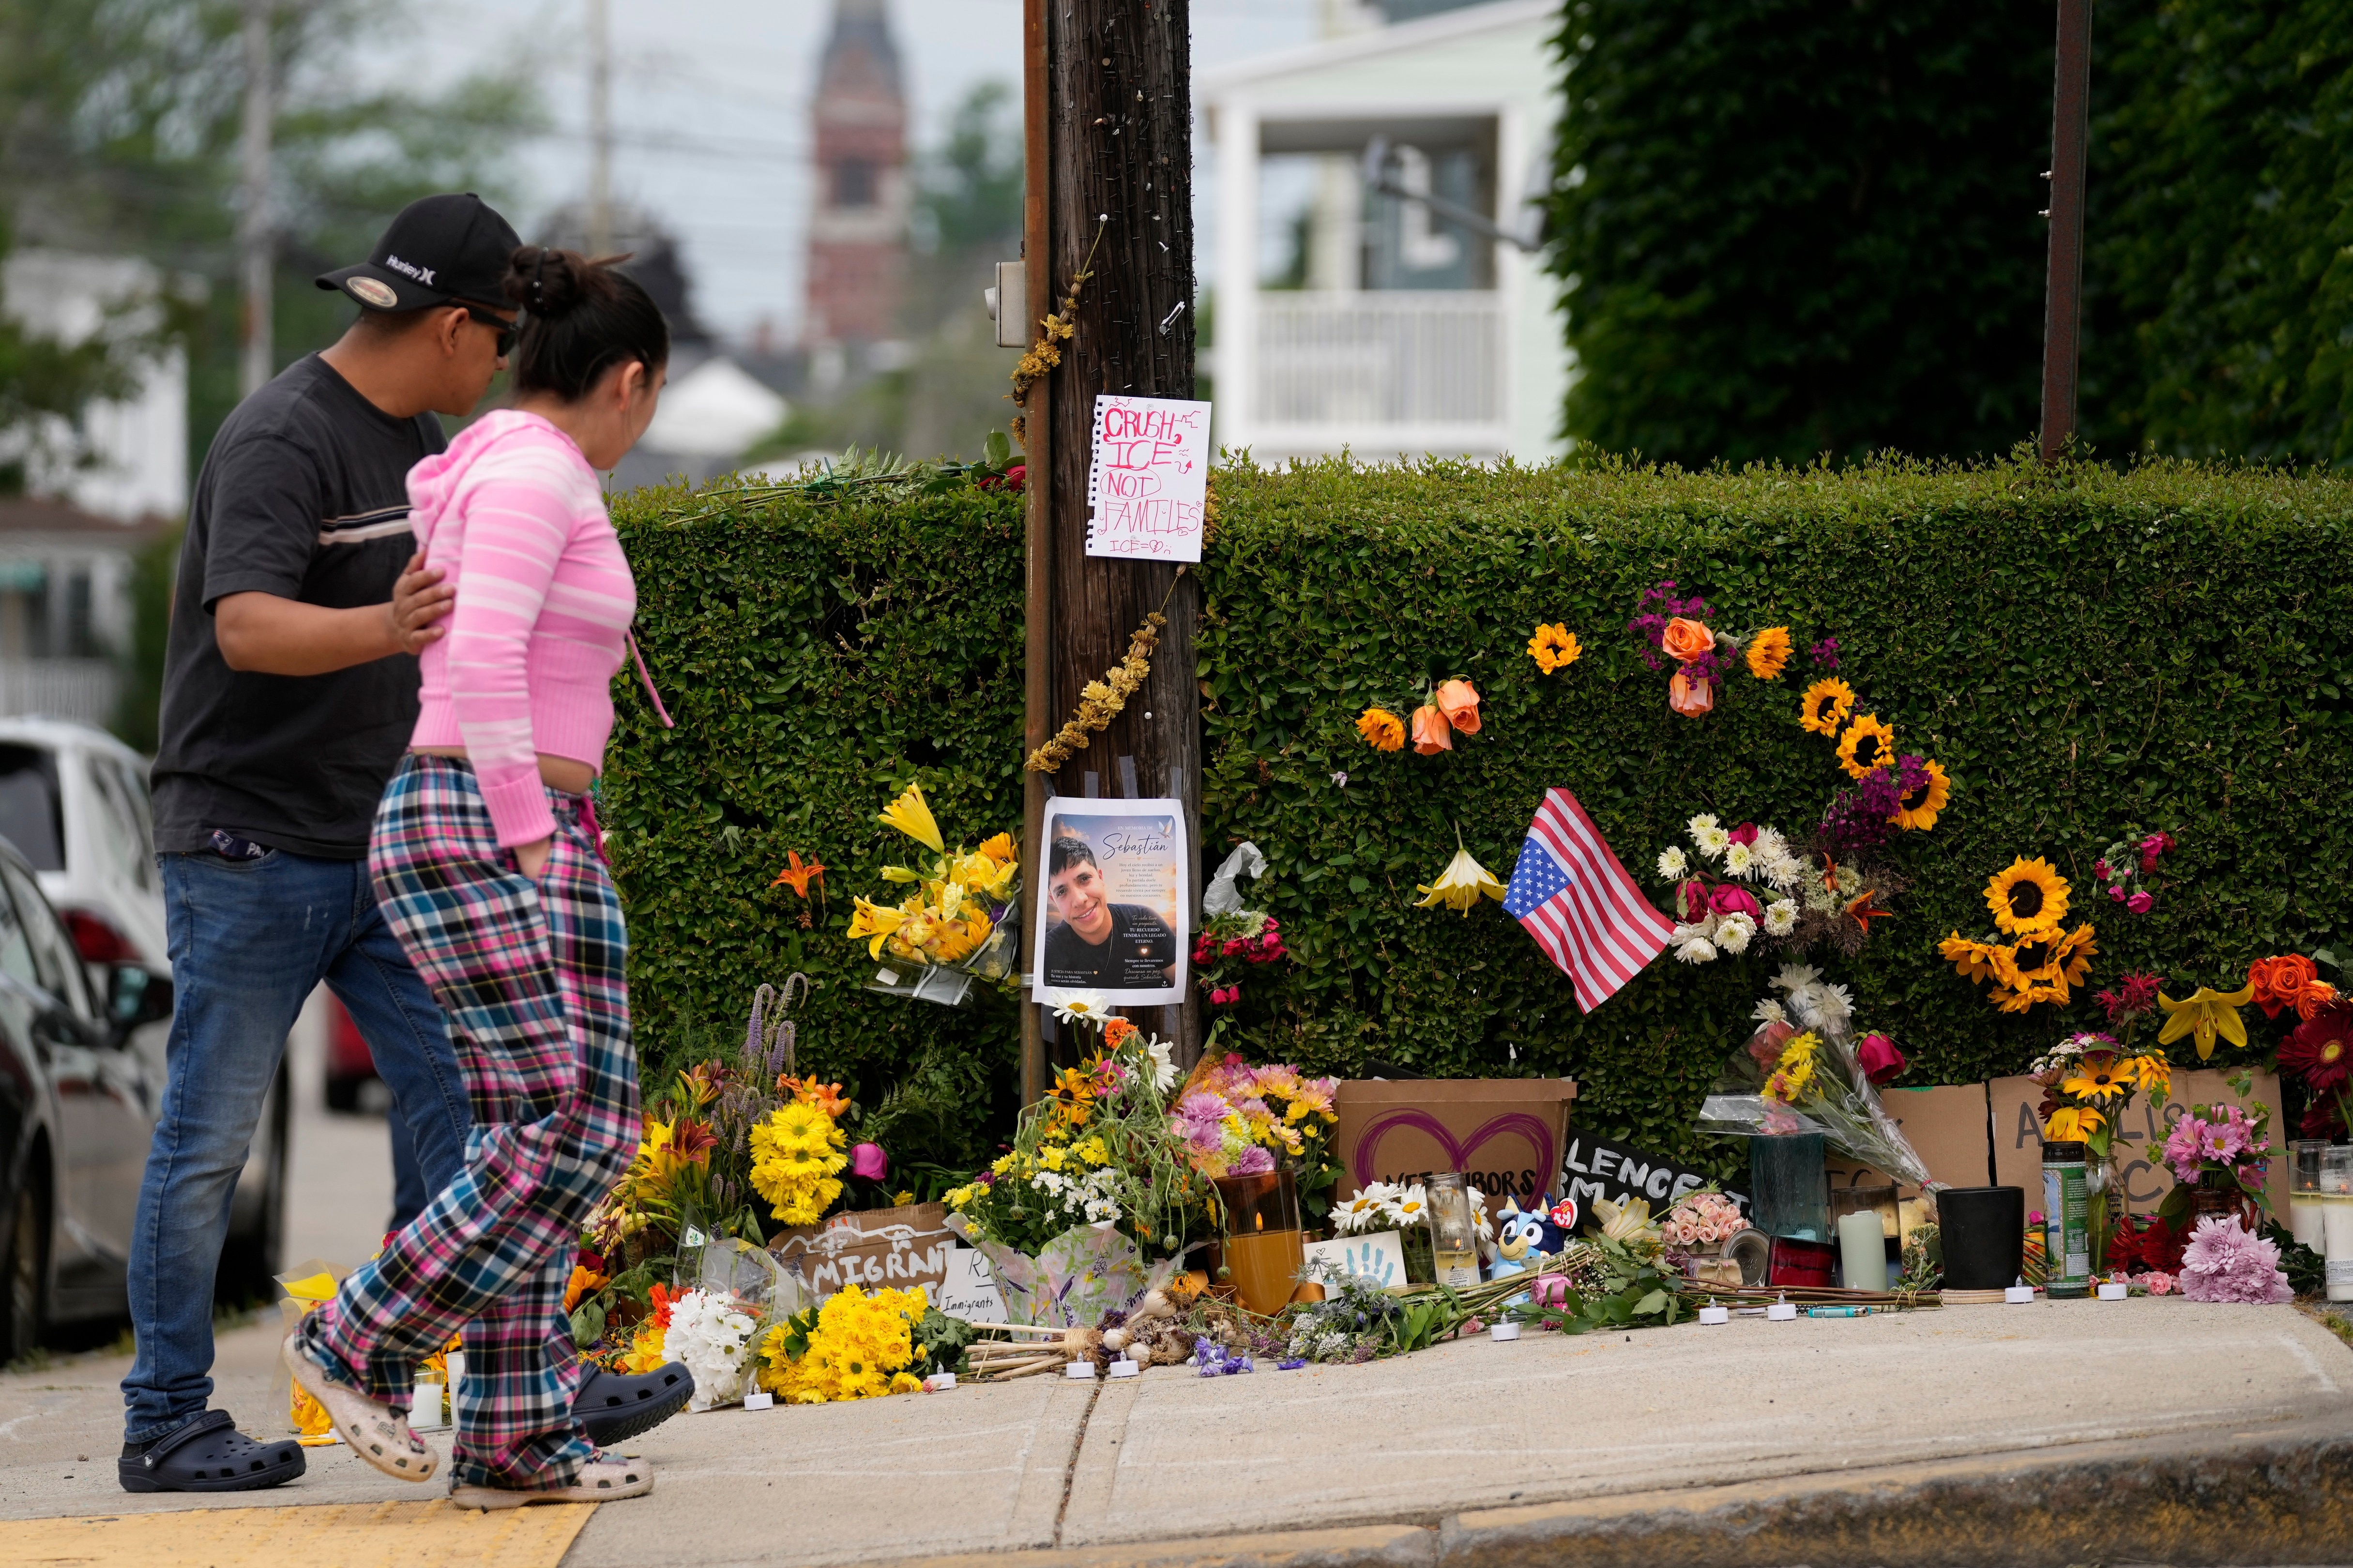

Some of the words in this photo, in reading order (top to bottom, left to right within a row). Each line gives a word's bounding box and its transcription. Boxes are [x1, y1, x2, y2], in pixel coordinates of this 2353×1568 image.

[385, 254, 422, 279] Hurley
[1108, 472, 1153, 498] NOT
[1553, 1211, 1571, 1225] ty
[943, 1296, 993, 1315] Immigrants
